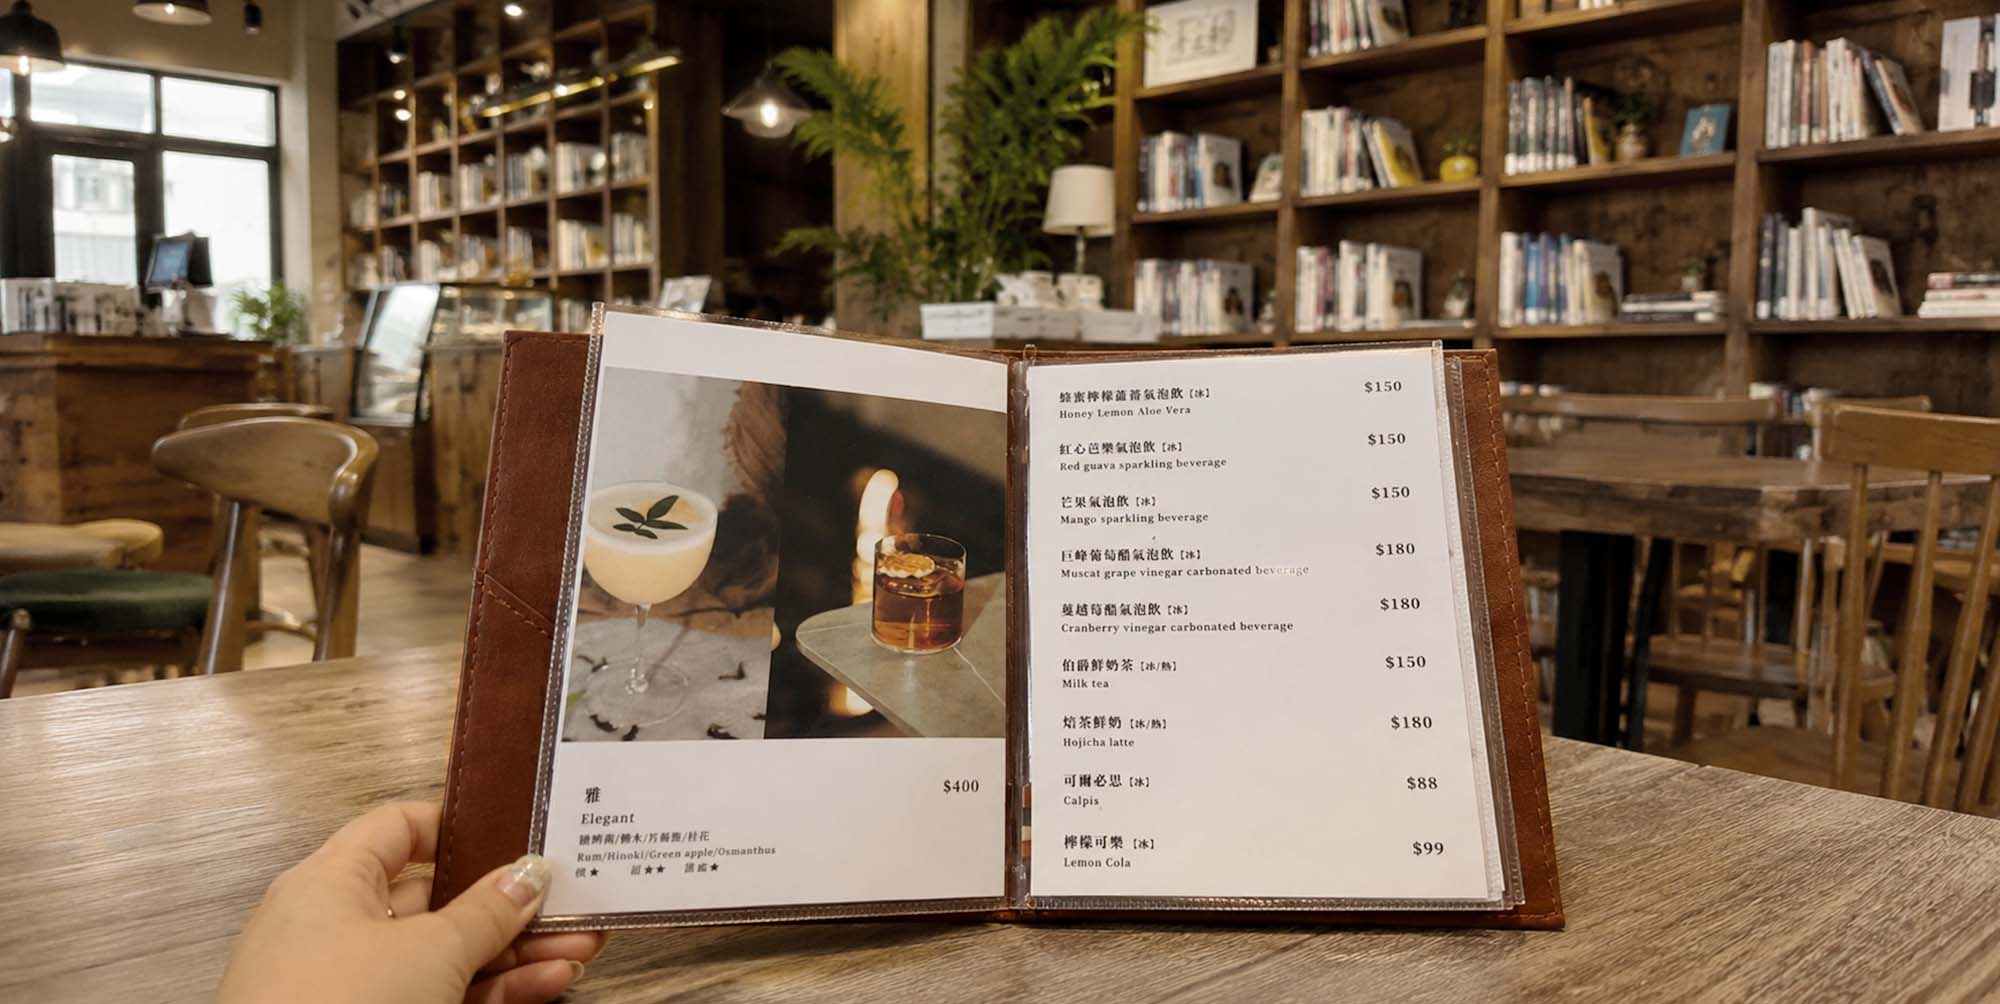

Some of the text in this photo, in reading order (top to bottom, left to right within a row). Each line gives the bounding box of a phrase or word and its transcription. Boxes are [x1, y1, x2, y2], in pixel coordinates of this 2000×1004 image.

[1364, 380, 1403, 395] $150
[1059, 405, 1192, 421] Honey Lemon Aloe Vera
[1367, 432, 1407, 447] $150
[1059, 458, 1227, 473] Red guava sparkling beverage
[1371, 485, 1411, 500] $150
[1060, 512, 1209, 527] Mango sparkling beverage
[1375, 542, 1416, 557] $180
[1060, 565, 1309, 581] Muscat grape vinegar carbonated beverage
[1380, 596, 1421, 611] $180
[1060, 620, 1294, 635] Cranberry vinegar carbonated beverage
[1384, 655, 1427, 670] $150
[1061, 677, 1110, 689] Milk tea
[1390, 715, 1433, 731] $180
[1063, 736, 1135, 750] Hojicha latte
[943, 778, 980, 795] $400
[1406, 775, 1439, 791] $88
[583, 786, 602, 805] 雅
[1063, 795, 1100, 809] Calpis
[580, 812, 635, 827] Elegant
[1412, 840, 1445, 857] $99
[1063, 856, 1132, 868] Lemon Cola
